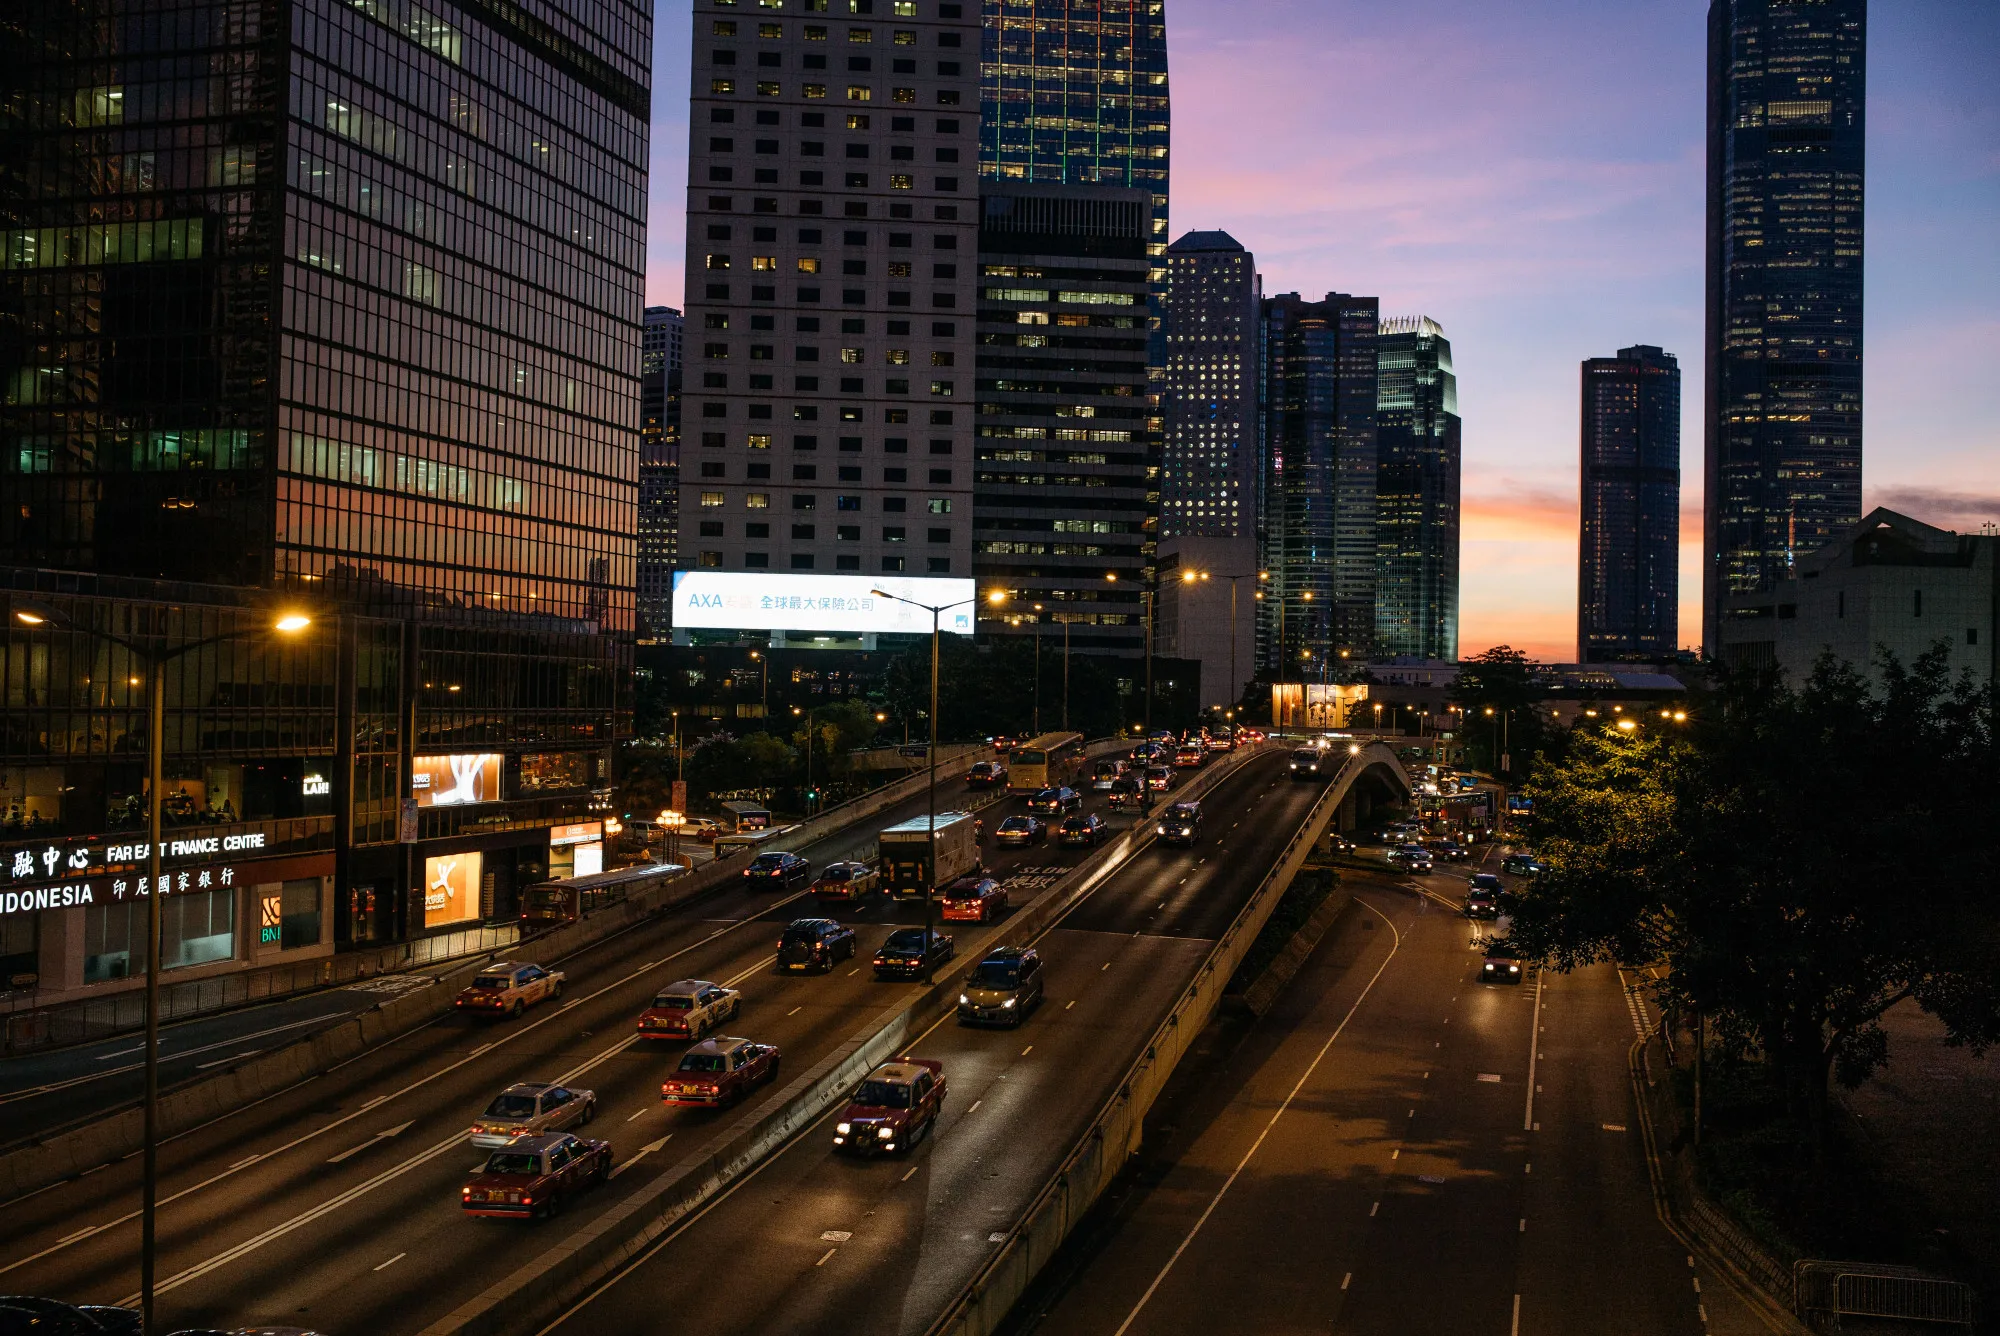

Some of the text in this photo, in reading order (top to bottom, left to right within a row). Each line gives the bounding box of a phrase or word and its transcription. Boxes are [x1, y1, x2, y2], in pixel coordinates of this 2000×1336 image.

[688, 593, 723, 608] AXA
[760, 595, 874, 612] 全球最大保險公司
[0, 846, 89, 878] 融中心
[107, 833, 265, 862] FAR EAT FINANCE CENTRE
[113, 867, 235, 900] 印尼國家銀行
[262, 926, 281, 943] BNI
